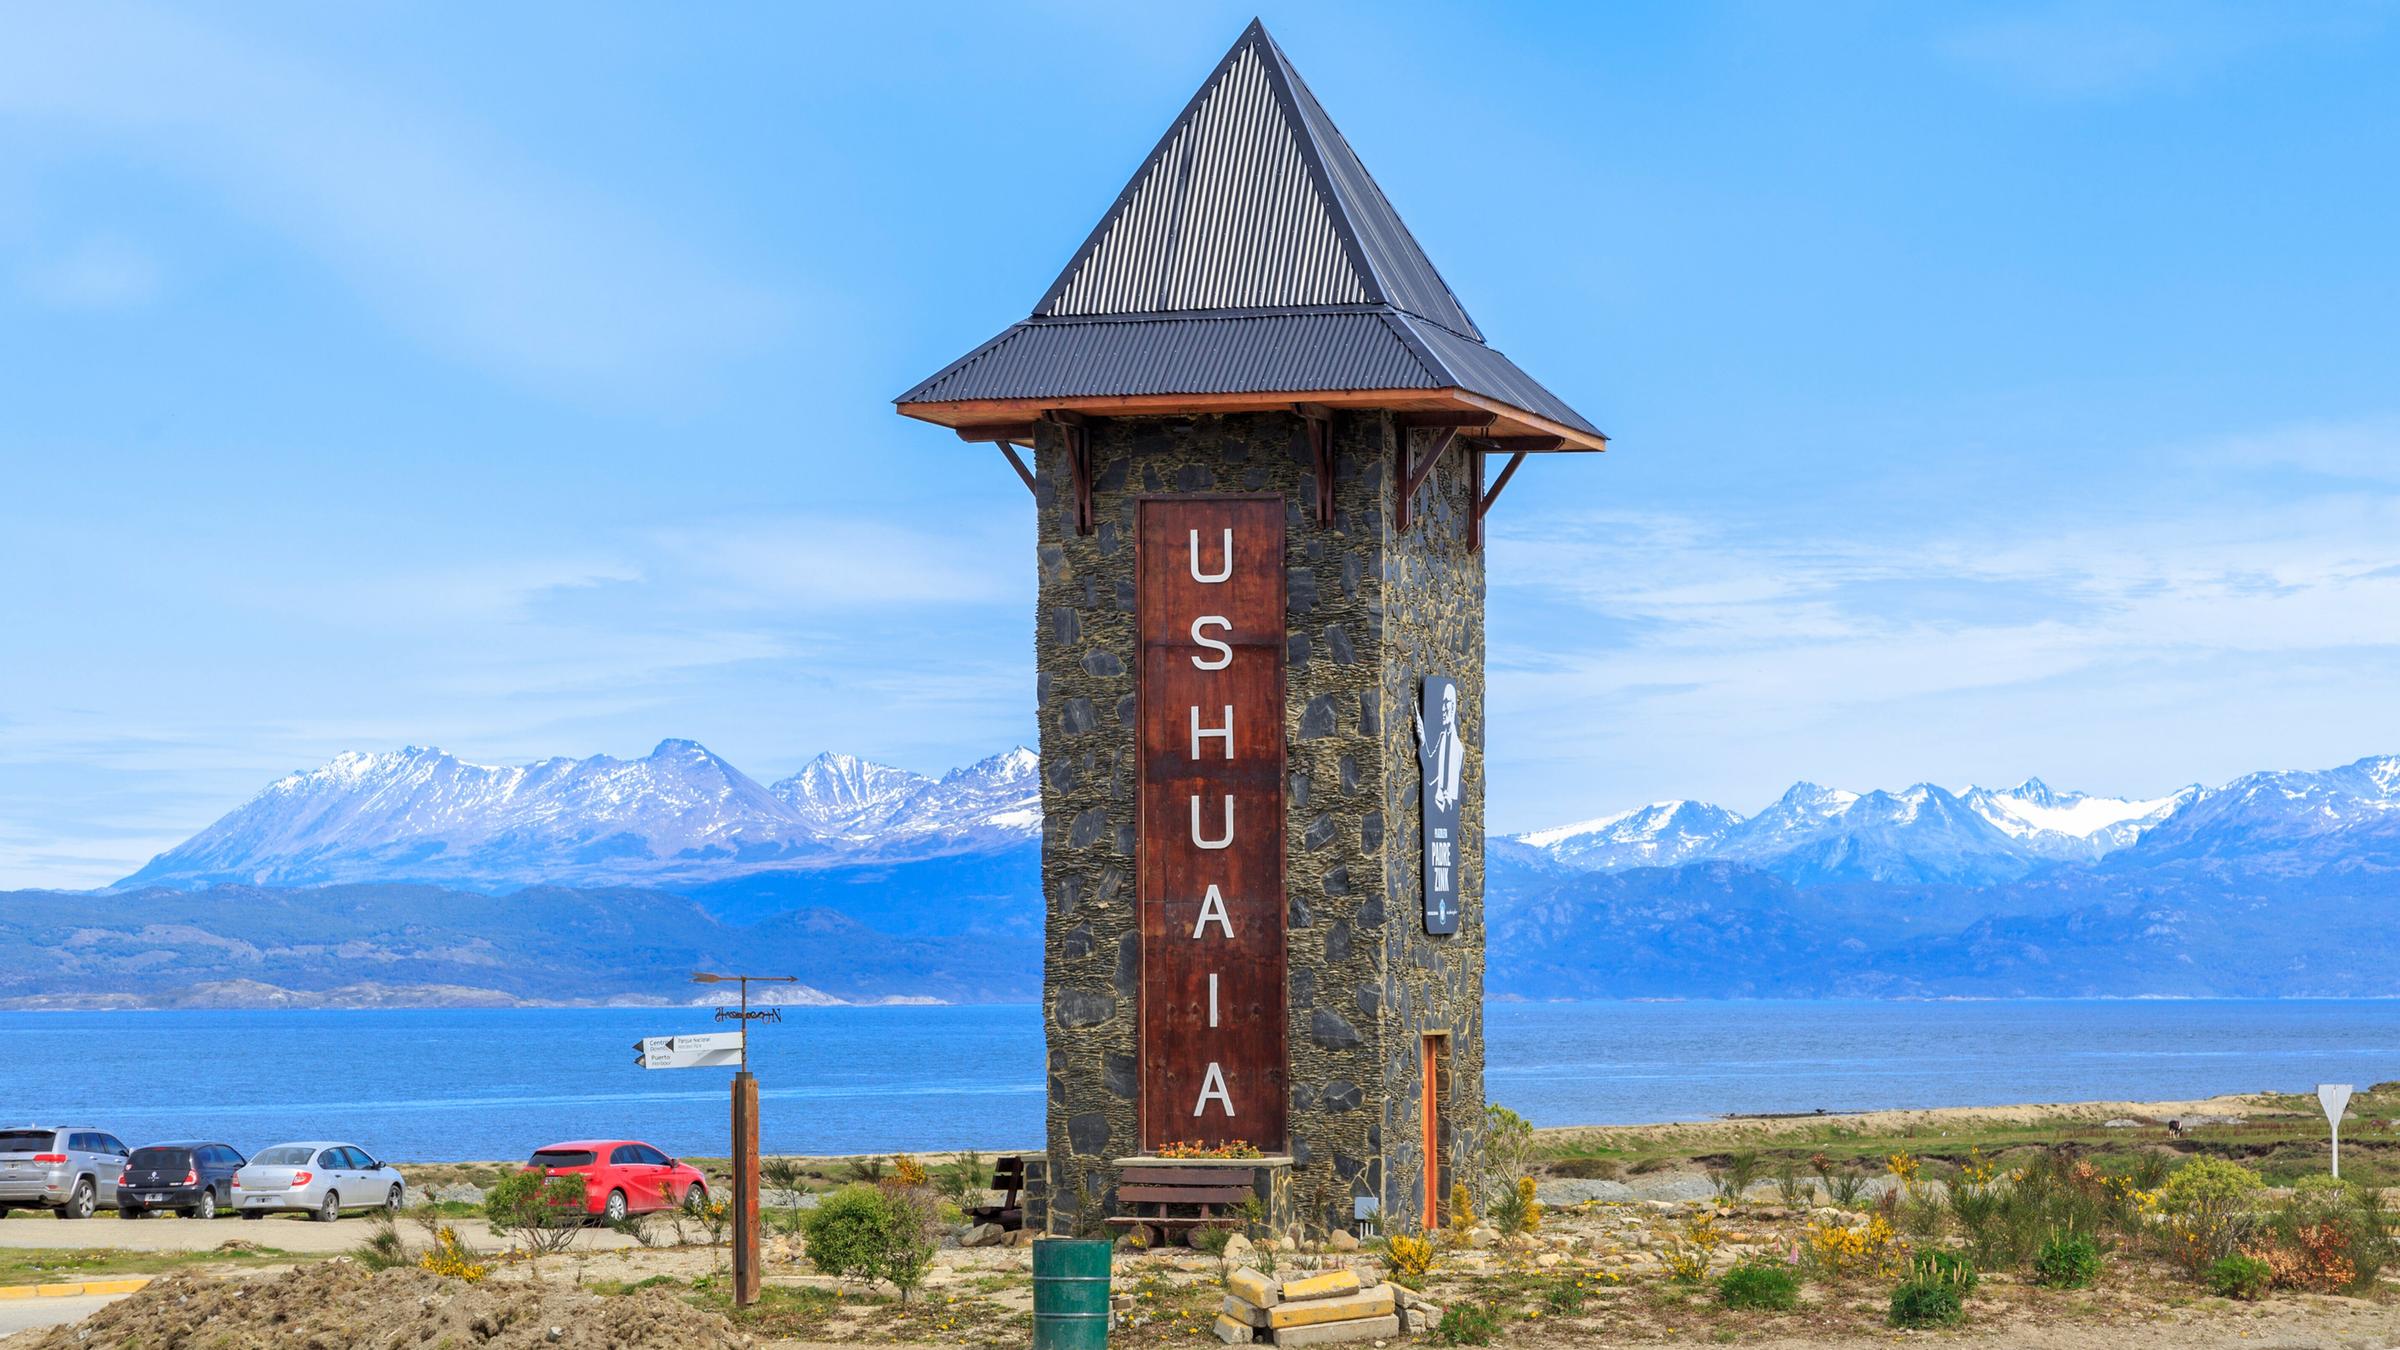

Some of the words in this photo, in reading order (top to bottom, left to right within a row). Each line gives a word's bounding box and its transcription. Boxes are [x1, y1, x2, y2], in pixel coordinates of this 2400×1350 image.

[1190, 528, 1236, 1117] USHUAIA
[1432, 842, 1451, 867] PADRE
[1434, 868, 1449, 892] ZINK
